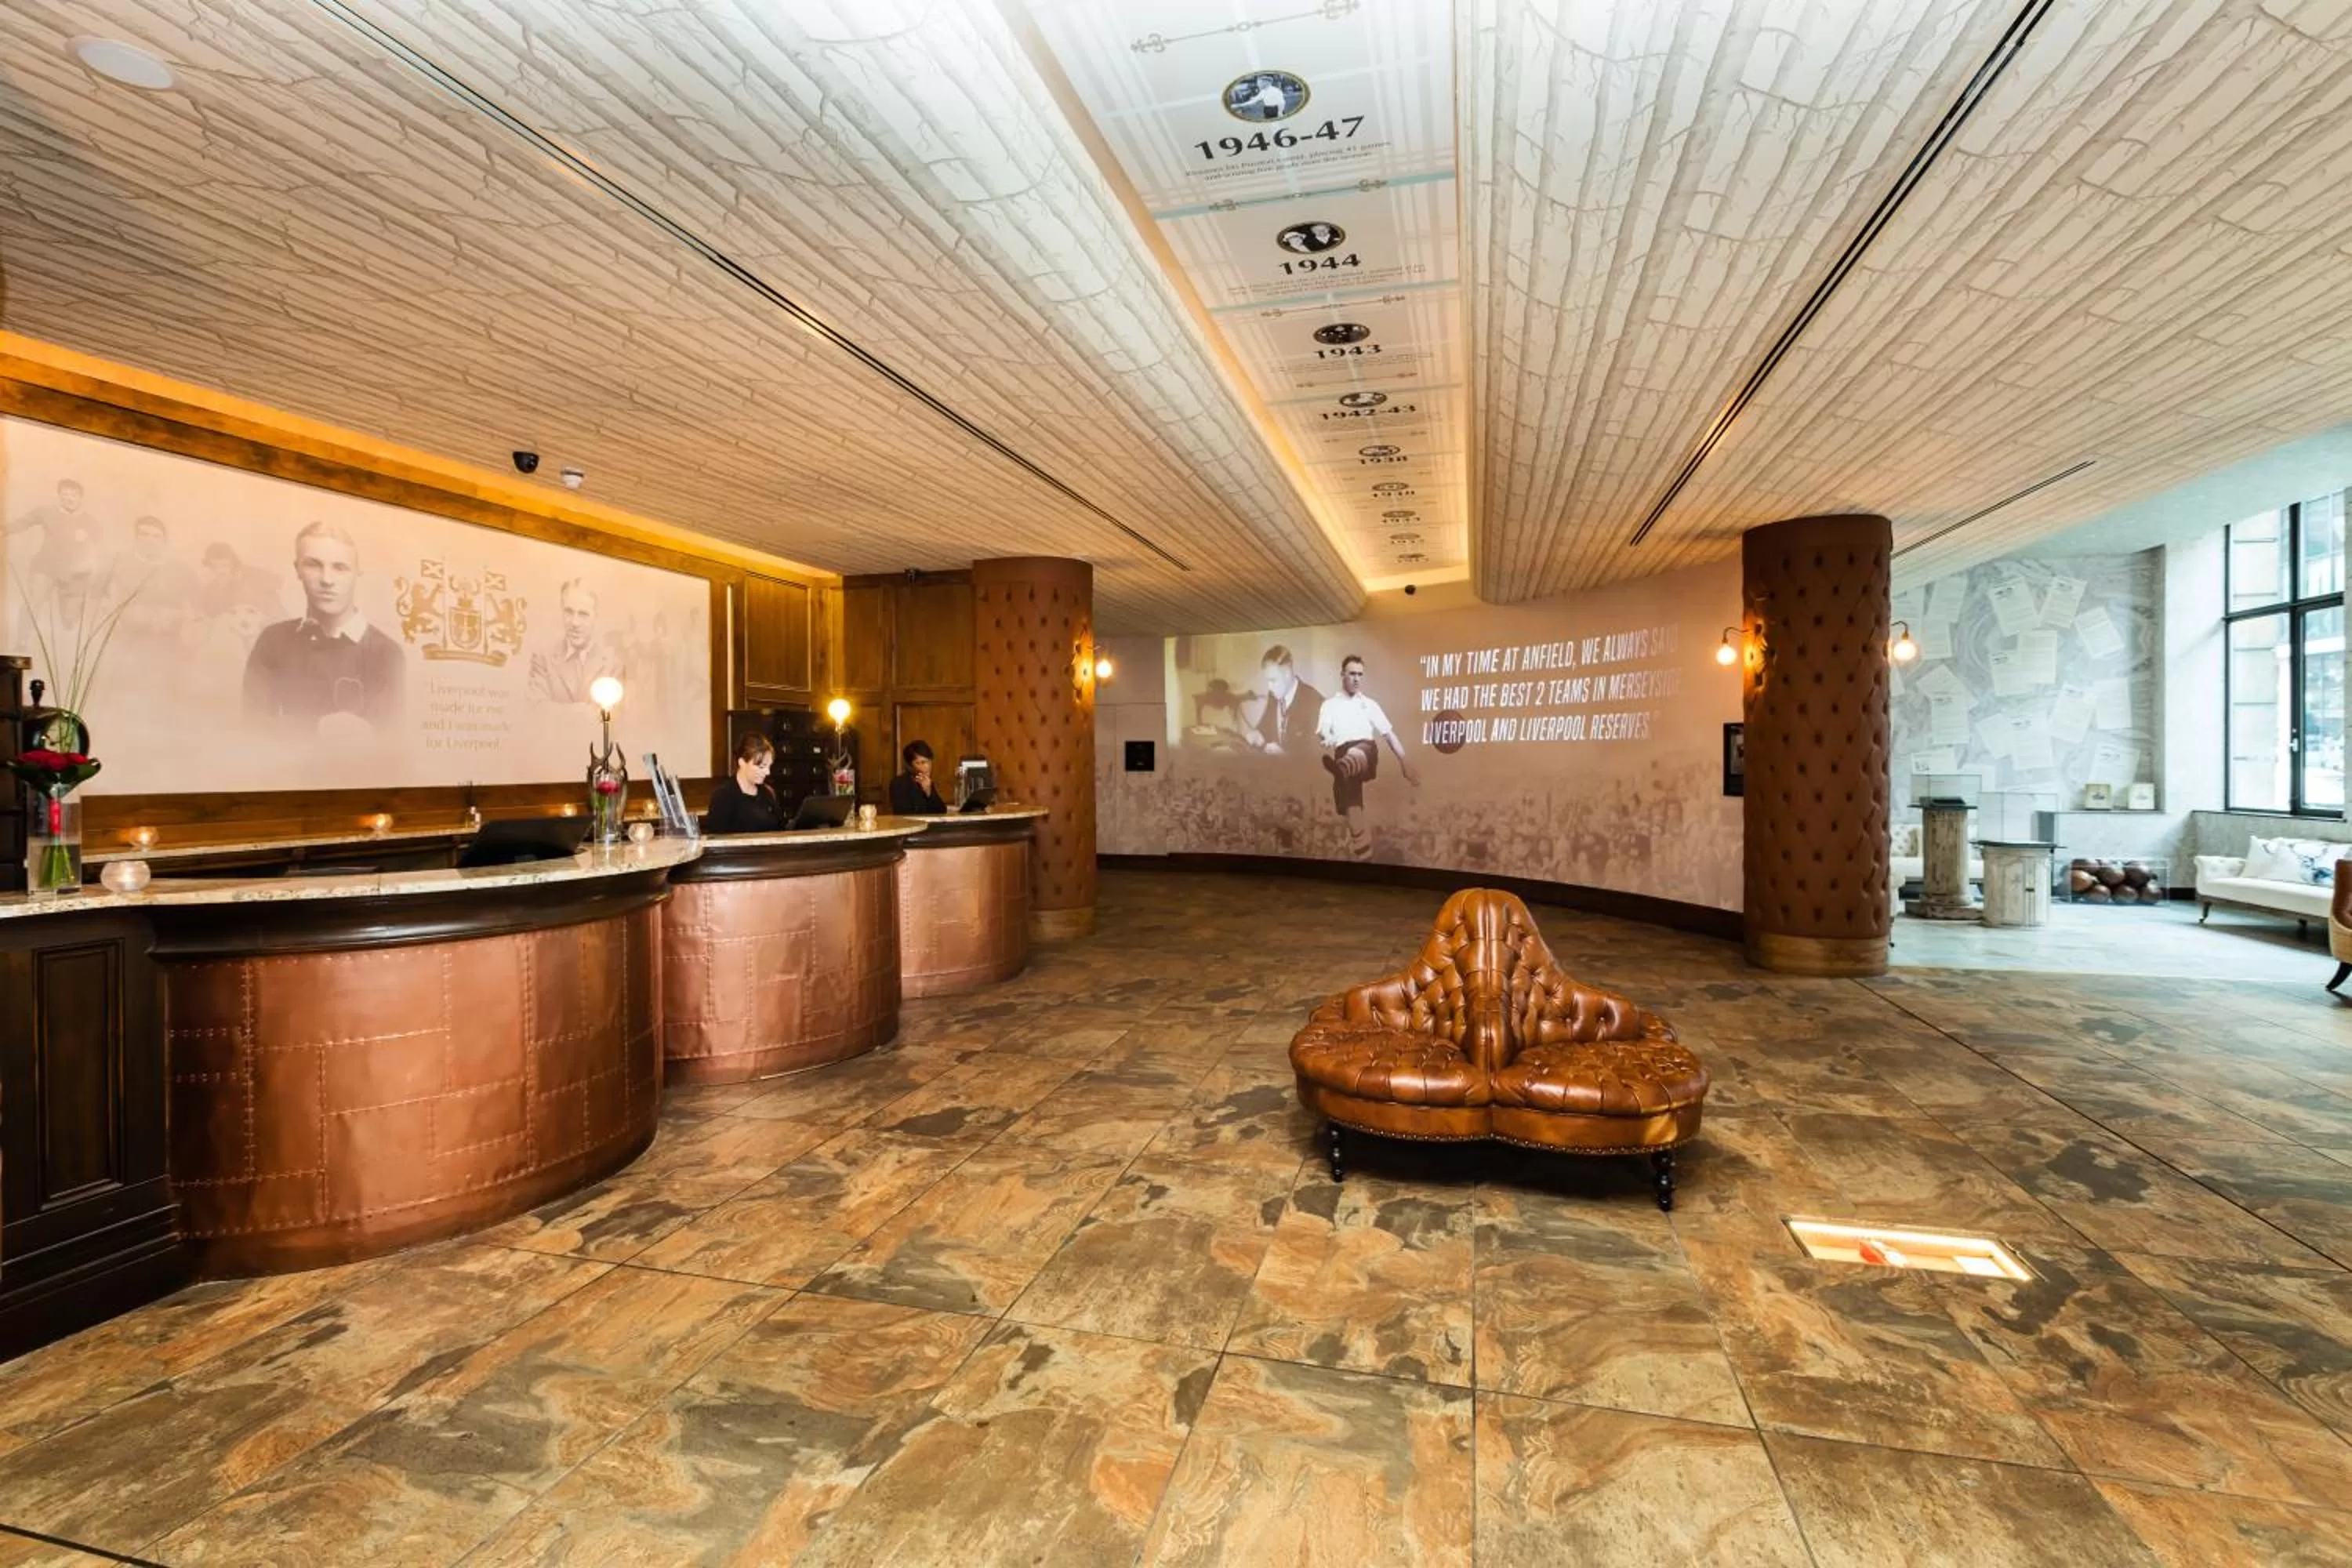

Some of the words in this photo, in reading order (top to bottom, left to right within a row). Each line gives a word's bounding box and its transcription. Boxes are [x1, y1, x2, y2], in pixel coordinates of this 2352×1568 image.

[1194, 115, 1365, 160] 1946-47
[1279, 253, 1362, 275] 1944
[1315, 344, 1382, 359] 1943
[1442, 652, 1462, 677] MY
[1467, 648, 1500, 675] TIME
[1501, 647, 1520, 672] AT
[1522, 641, 1577, 671] ANFIELD,
[1581, 637, 1602, 665] WE
[1602, 629, 1649, 662] ALWAYS
[1421, 688, 1440, 711] WE
[1443, 686, 1468, 710] HAD
[1473, 684, 1498, 708] THE
[1500, 682, 1534, 707] BEST
[1534, 681, 1545, 706] 2
[1548, 677, 1591, 705] TEAMS
[1592, 675, 1606, 702] IN
[1422, 718, 1487, 744] LIVERPOOL
[1490, 717, 1517, 742] AND
[1519, 715, 1586, 741] LIVERPOOL
